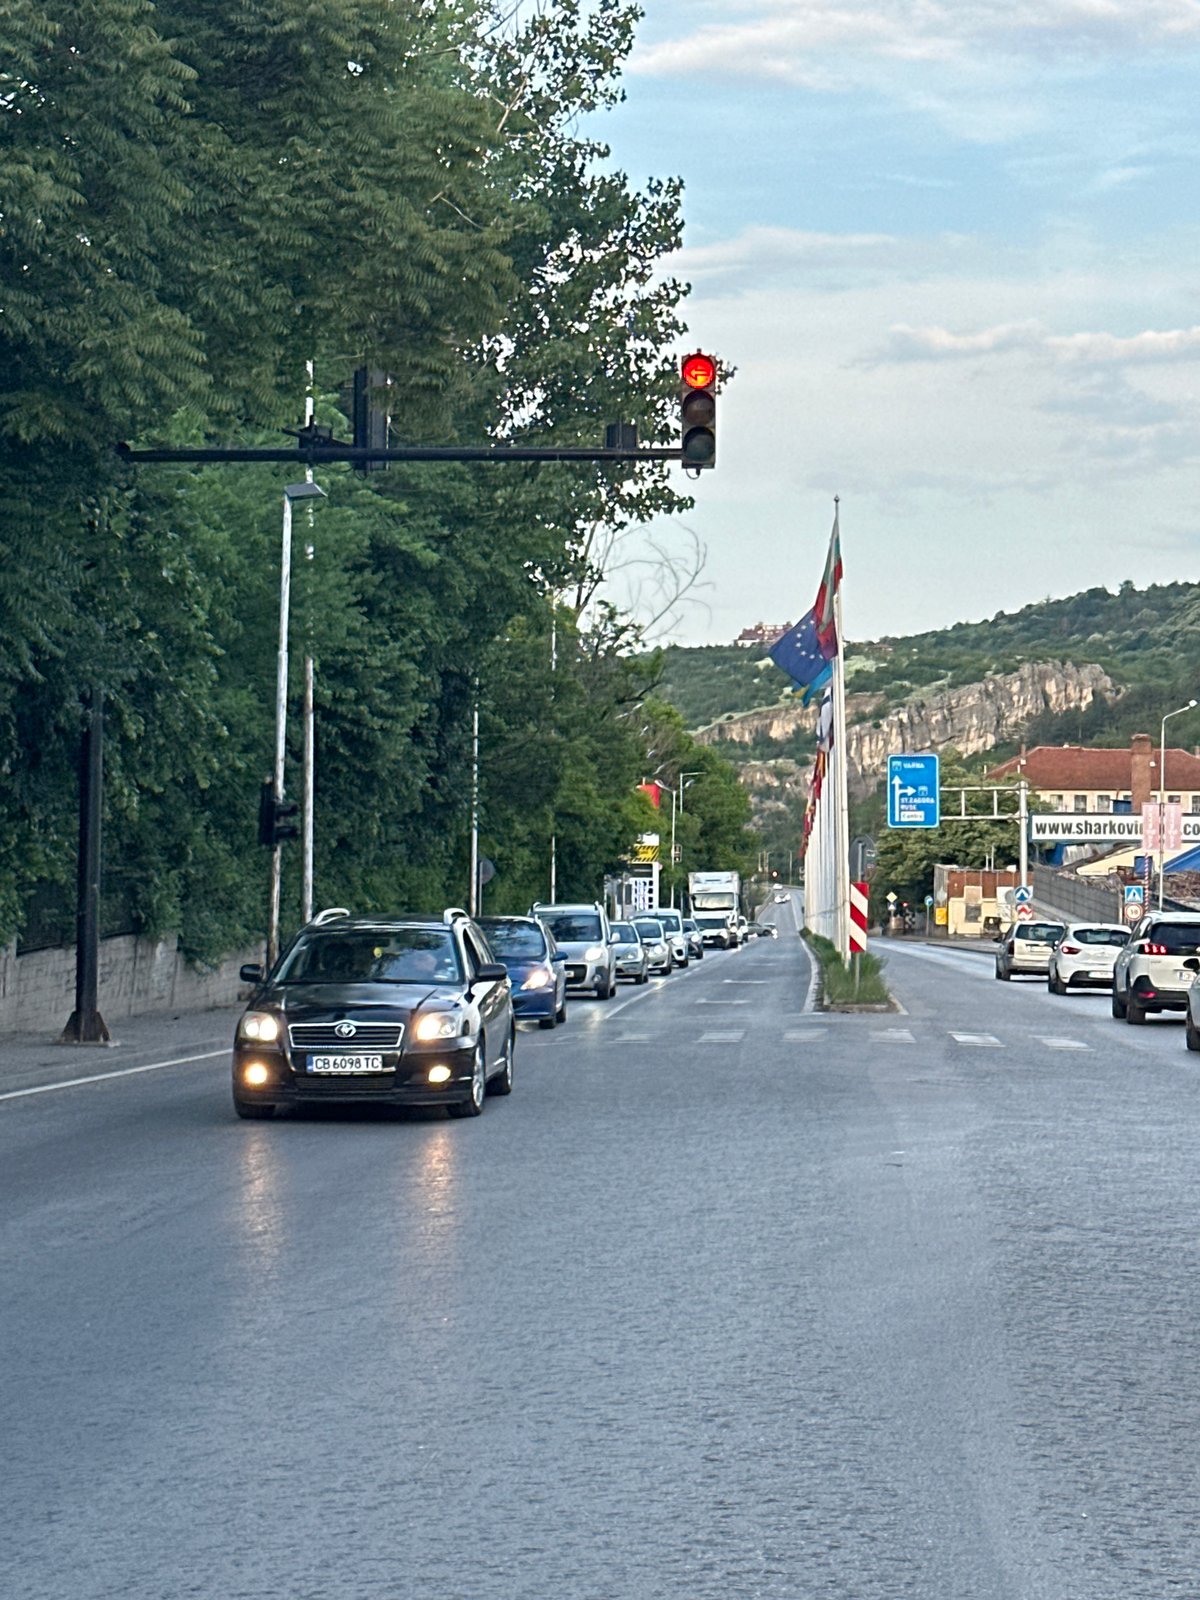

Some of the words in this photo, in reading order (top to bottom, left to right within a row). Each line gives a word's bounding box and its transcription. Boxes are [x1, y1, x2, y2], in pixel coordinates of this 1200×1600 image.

[315, 1058, 330, 1069] CB
[332, 1057, 362, 1069] 6098
[363, 1057, 379, 1069] TC
